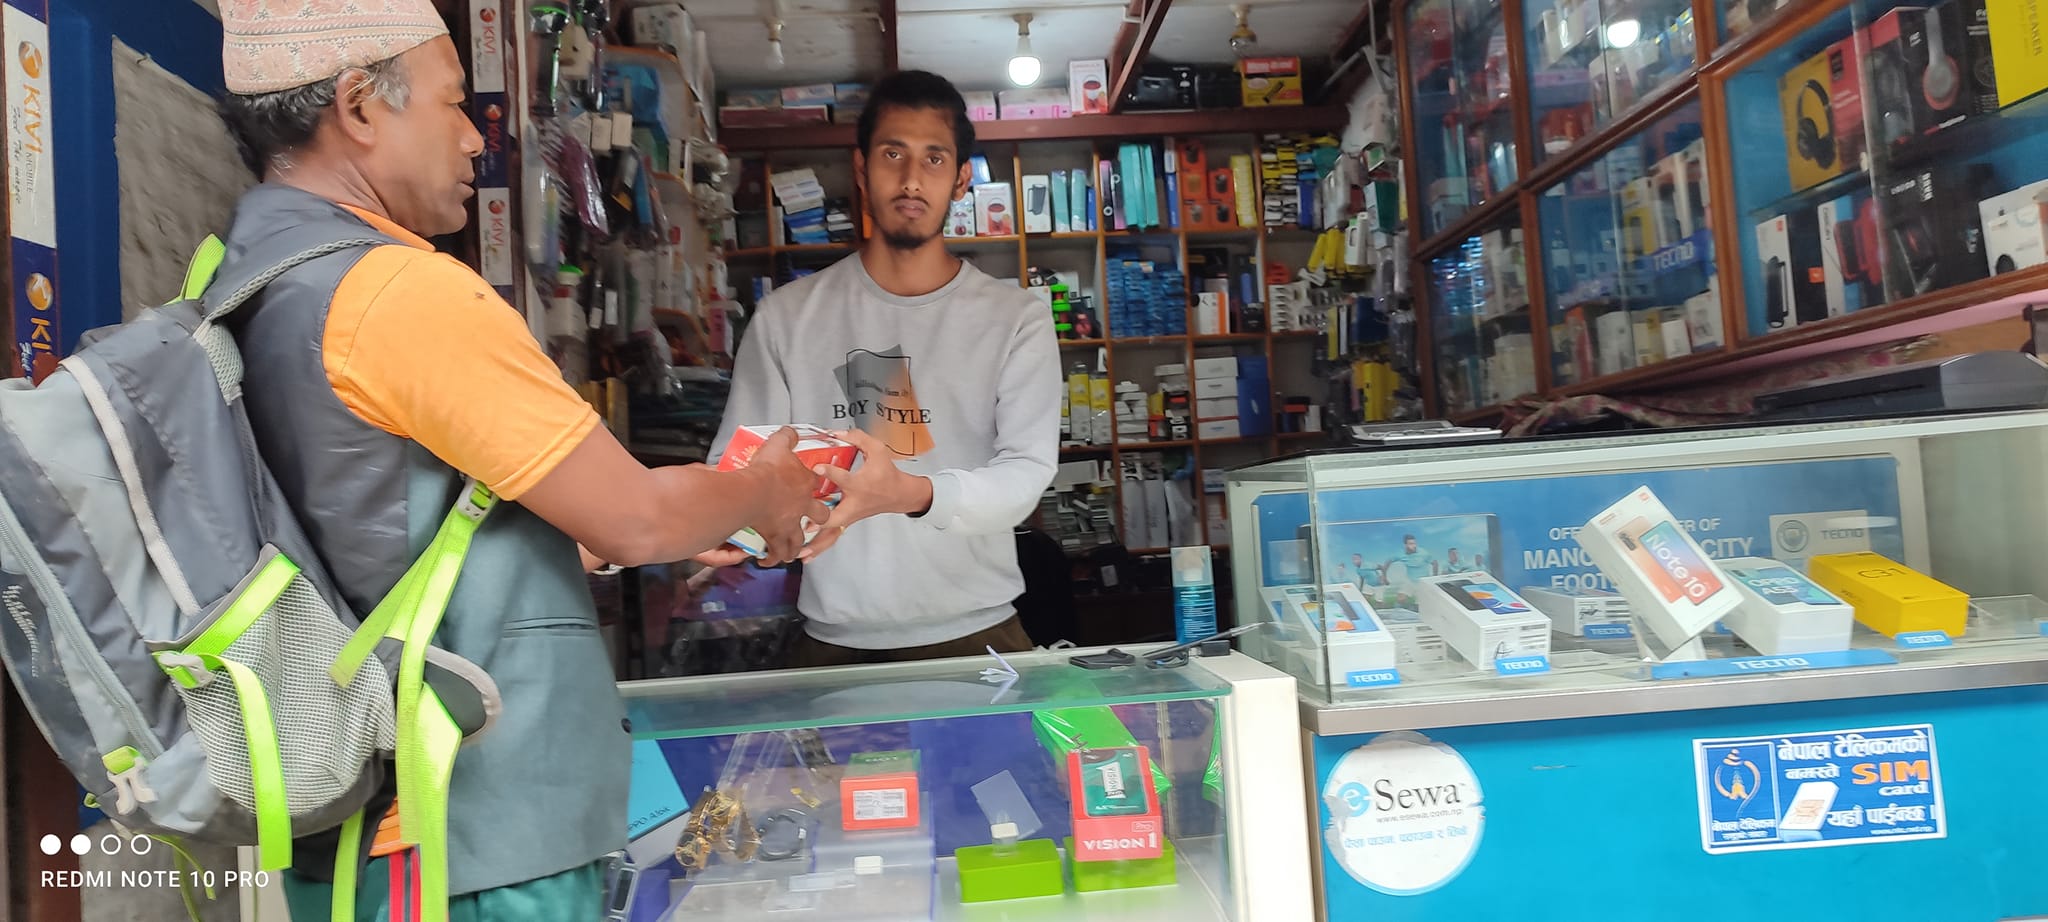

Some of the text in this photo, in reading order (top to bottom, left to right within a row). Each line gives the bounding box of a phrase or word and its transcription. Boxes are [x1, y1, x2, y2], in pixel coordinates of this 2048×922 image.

[482, 25, 496, 55] KIVI
[23, 84, 43, 154] KIVI
[25, 152, 34, 193] MOBILE
[490, 217, 505, 247] KIVI
[1654, 241, 1695, 271] TECNO
[832, 399, 931, 424] BOY STYLE
[1698, 517, 1721, 532] OF
[1820, 528, 1863, 540] TECNO
[1700, 536, 1754, 559] CITY
[1858, 567, 1907, 579] C31
[1589, 627, 1626, 635] TECNO
[1904, 634, 1945, 644] TECNO
[1502, 660, 1544, 671] TECNO
[1731, 657, 1809, 670] TECNO
[1352, 673, 1394, 683] TECNO
[1777, 730, 1929, 761] नेपाल टेलिकमको
[1785, 763, 1841, 780] नमस्ते
[1851, 760, 1931, 785] SIM
[1337, 778, 1461, 818] eSewa
[1878, 782, 1930, 796] card
[1083, 832, 1158, 850] VISION 1
